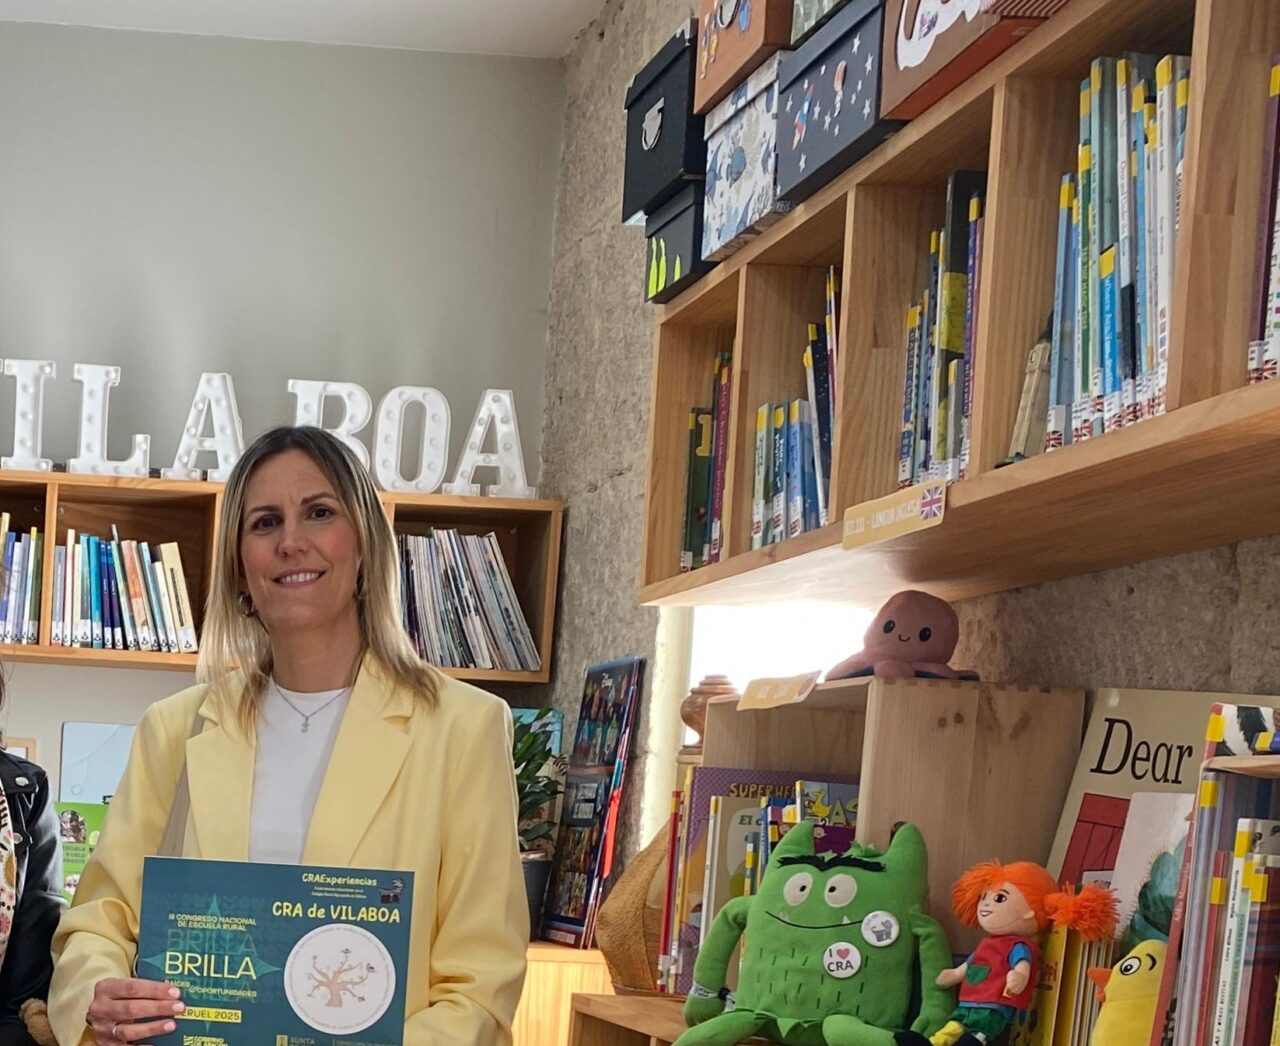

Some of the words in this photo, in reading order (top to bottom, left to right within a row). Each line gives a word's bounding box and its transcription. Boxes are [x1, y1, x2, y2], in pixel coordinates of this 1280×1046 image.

[1090, 717, 1194, 786] Dear
[738, 815, 754, 826] El
[302, 873, 378, 886] CRAExperiencias
[272, 902, 303, 917] CRA
[307, 903, 326, 918] de
[330, 905, 400, 923] VILABOA
[176, 914, 218, 922] CONGRESO
[219, 917, 256, 925] NACIONAL
[828, 948, 833, 957] I
[164, 952, 257, 980] BRILLA
[827, 960, 854, 972] CRA
[181, 1008, 212, 1019] ERUEL
[214, 1010, 240, 1020] 2025
